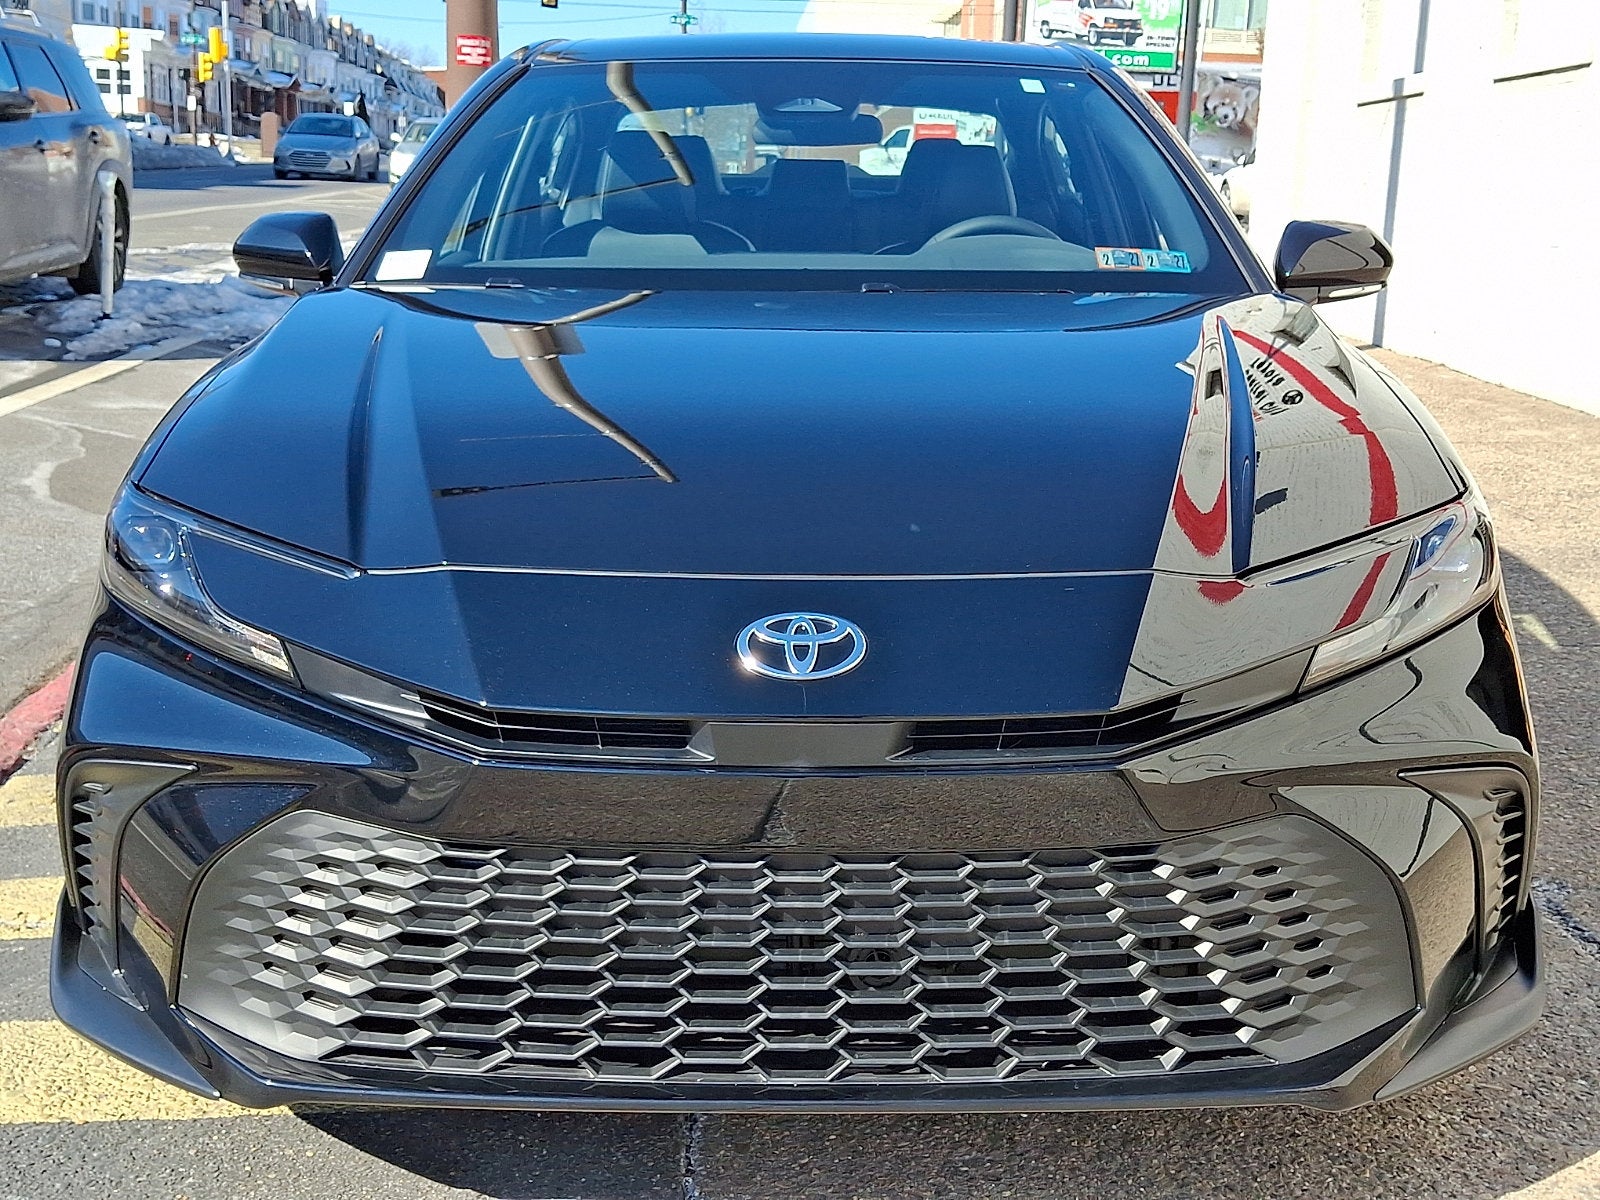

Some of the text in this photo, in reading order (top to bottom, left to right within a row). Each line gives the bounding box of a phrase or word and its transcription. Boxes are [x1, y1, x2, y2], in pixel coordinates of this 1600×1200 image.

[1102, 252, 1139, 266] 2 27
[1147, 255, 1185, 268] 2 27
